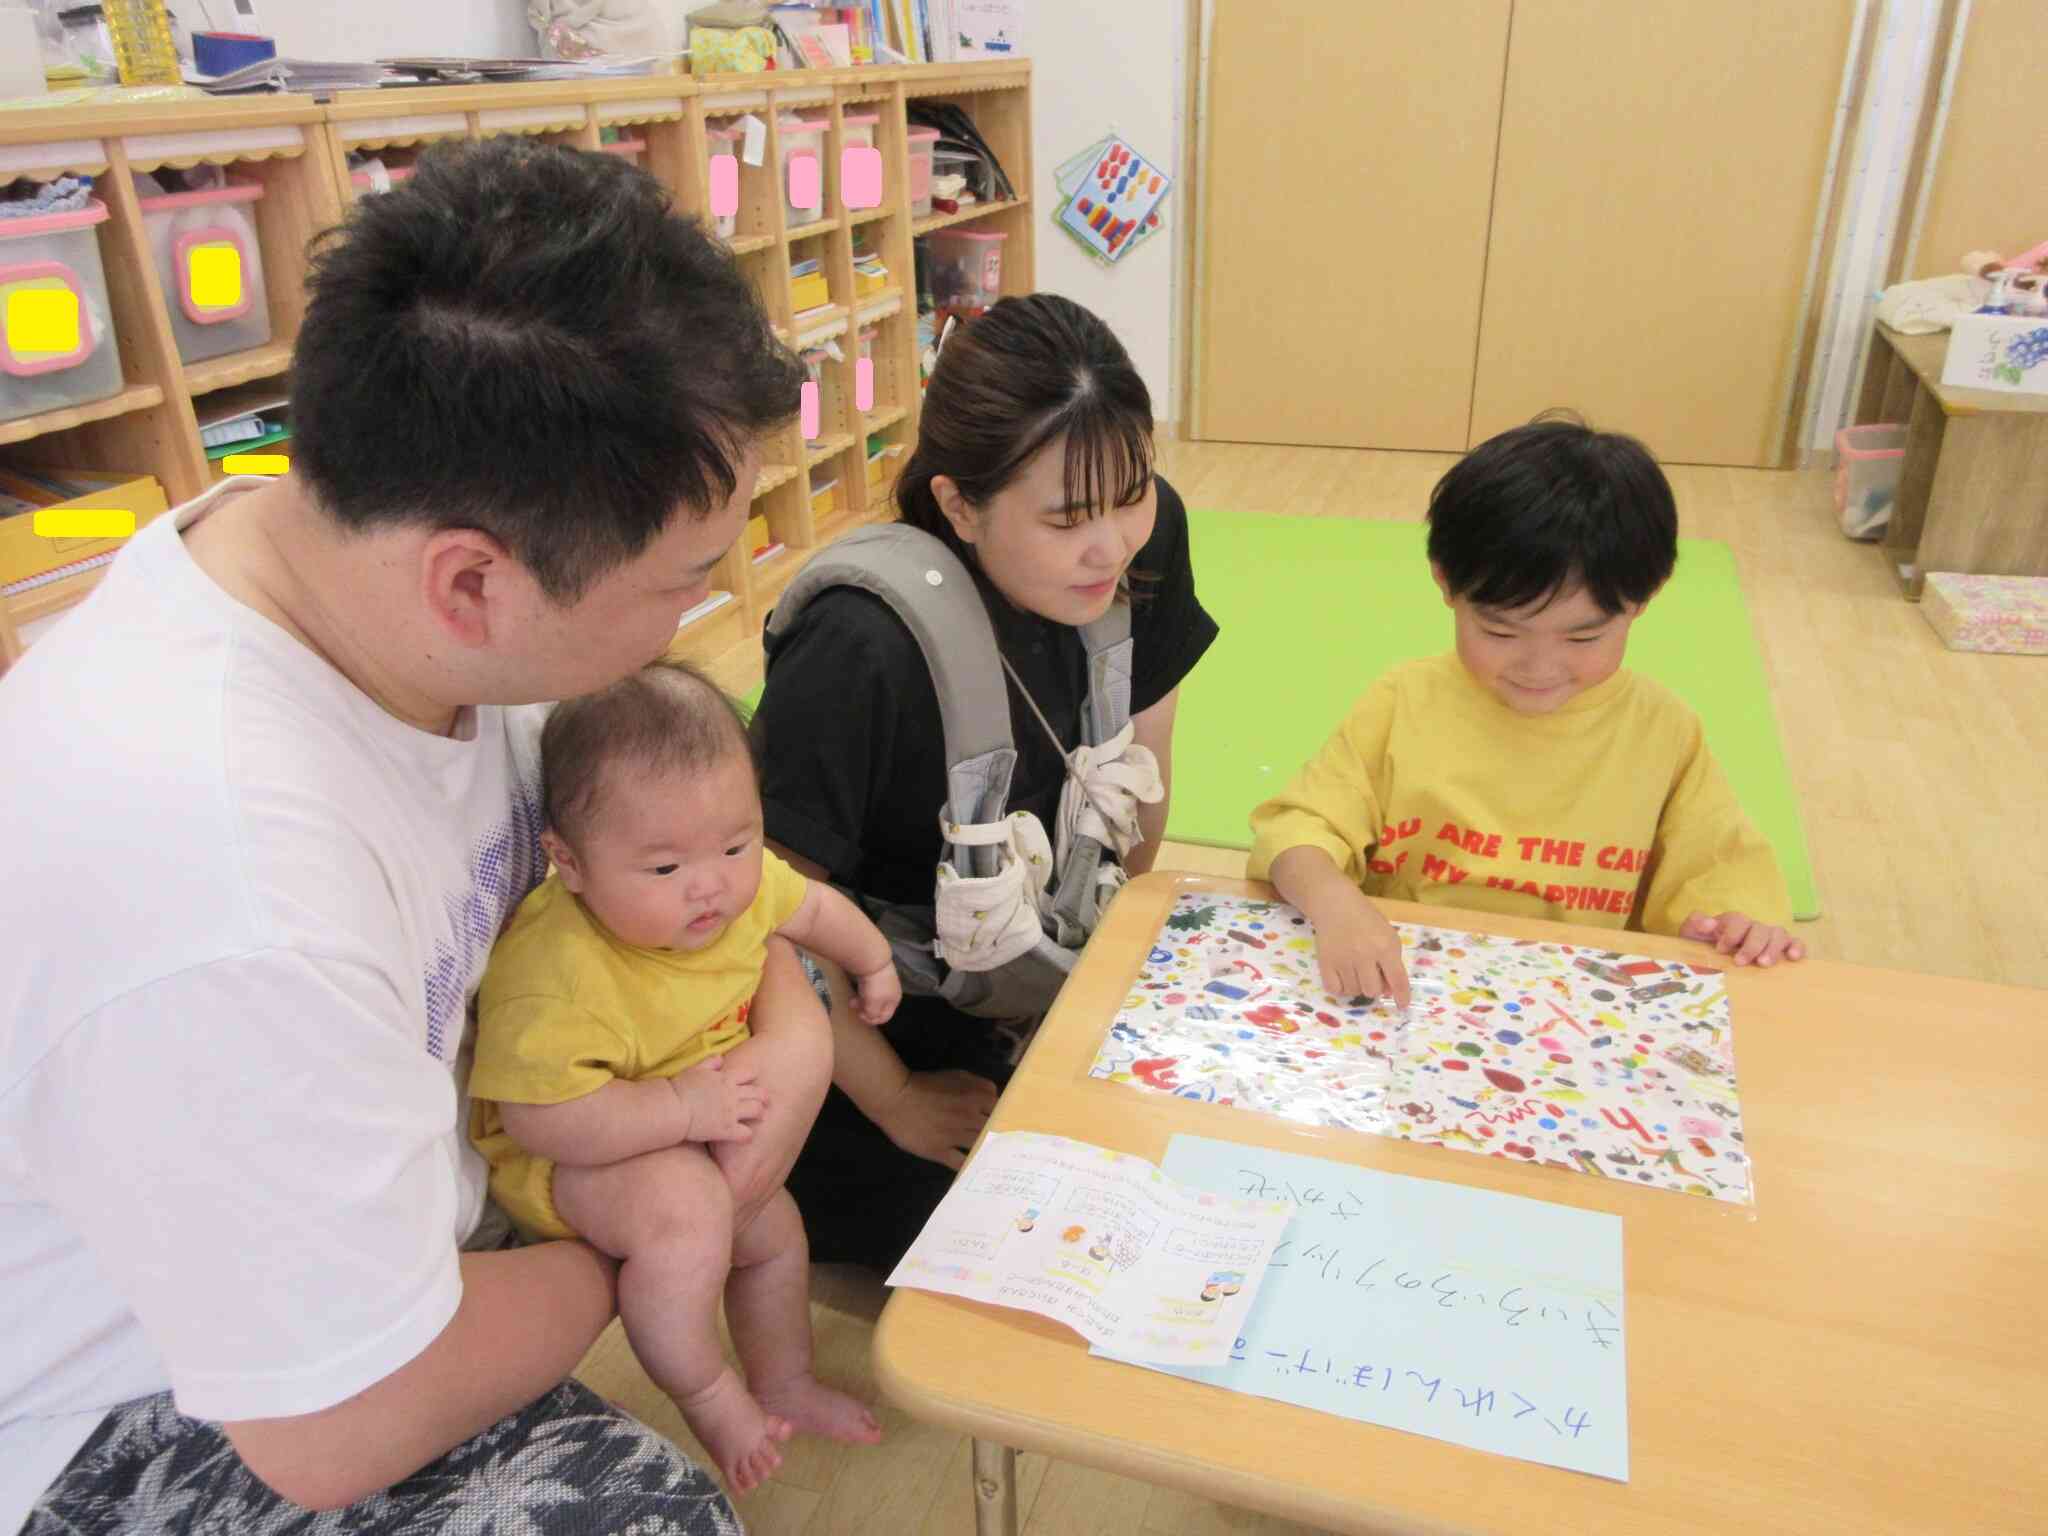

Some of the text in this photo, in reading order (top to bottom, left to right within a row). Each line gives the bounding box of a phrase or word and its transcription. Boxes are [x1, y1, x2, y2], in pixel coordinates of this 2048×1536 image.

[1437, 821, 1502, 859] ARE
[1517, 837, 1585, 867] THE
[1423, 853, 1469, 885] MY
